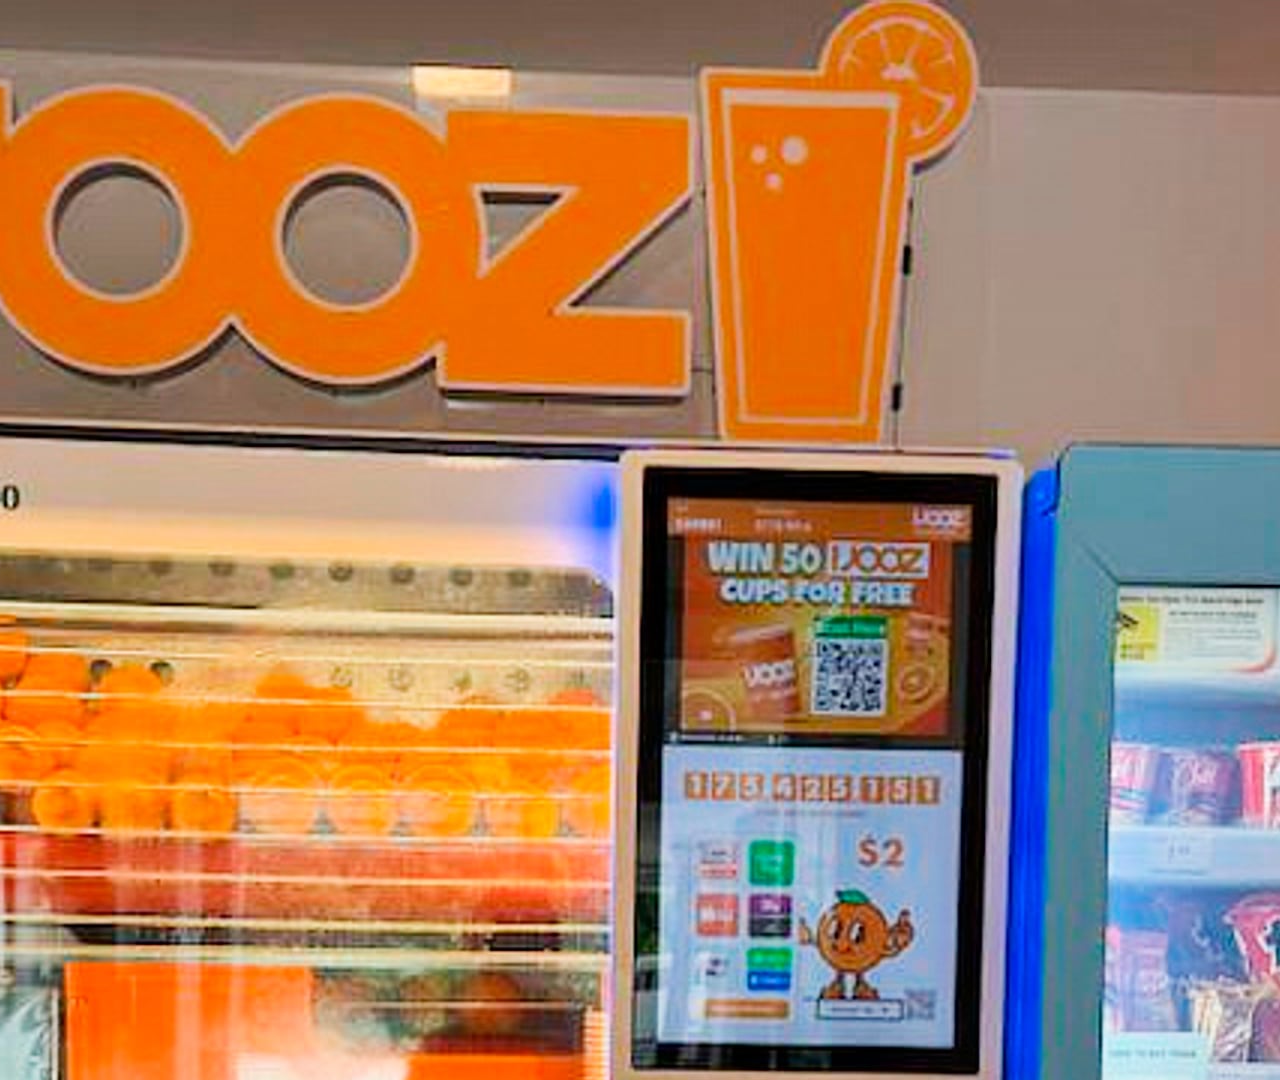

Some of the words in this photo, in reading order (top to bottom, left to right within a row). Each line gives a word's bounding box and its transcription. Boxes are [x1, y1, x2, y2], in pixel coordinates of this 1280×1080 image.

[708, 542, 768, 572] WIN
[782, 542, 823, 573] 50
[721, 578, 787, 604] CUPS
[794, 580, 843, 606] FOR
[853, 582, 913, 607] FREE
[857, 837, 905, 868] $2
